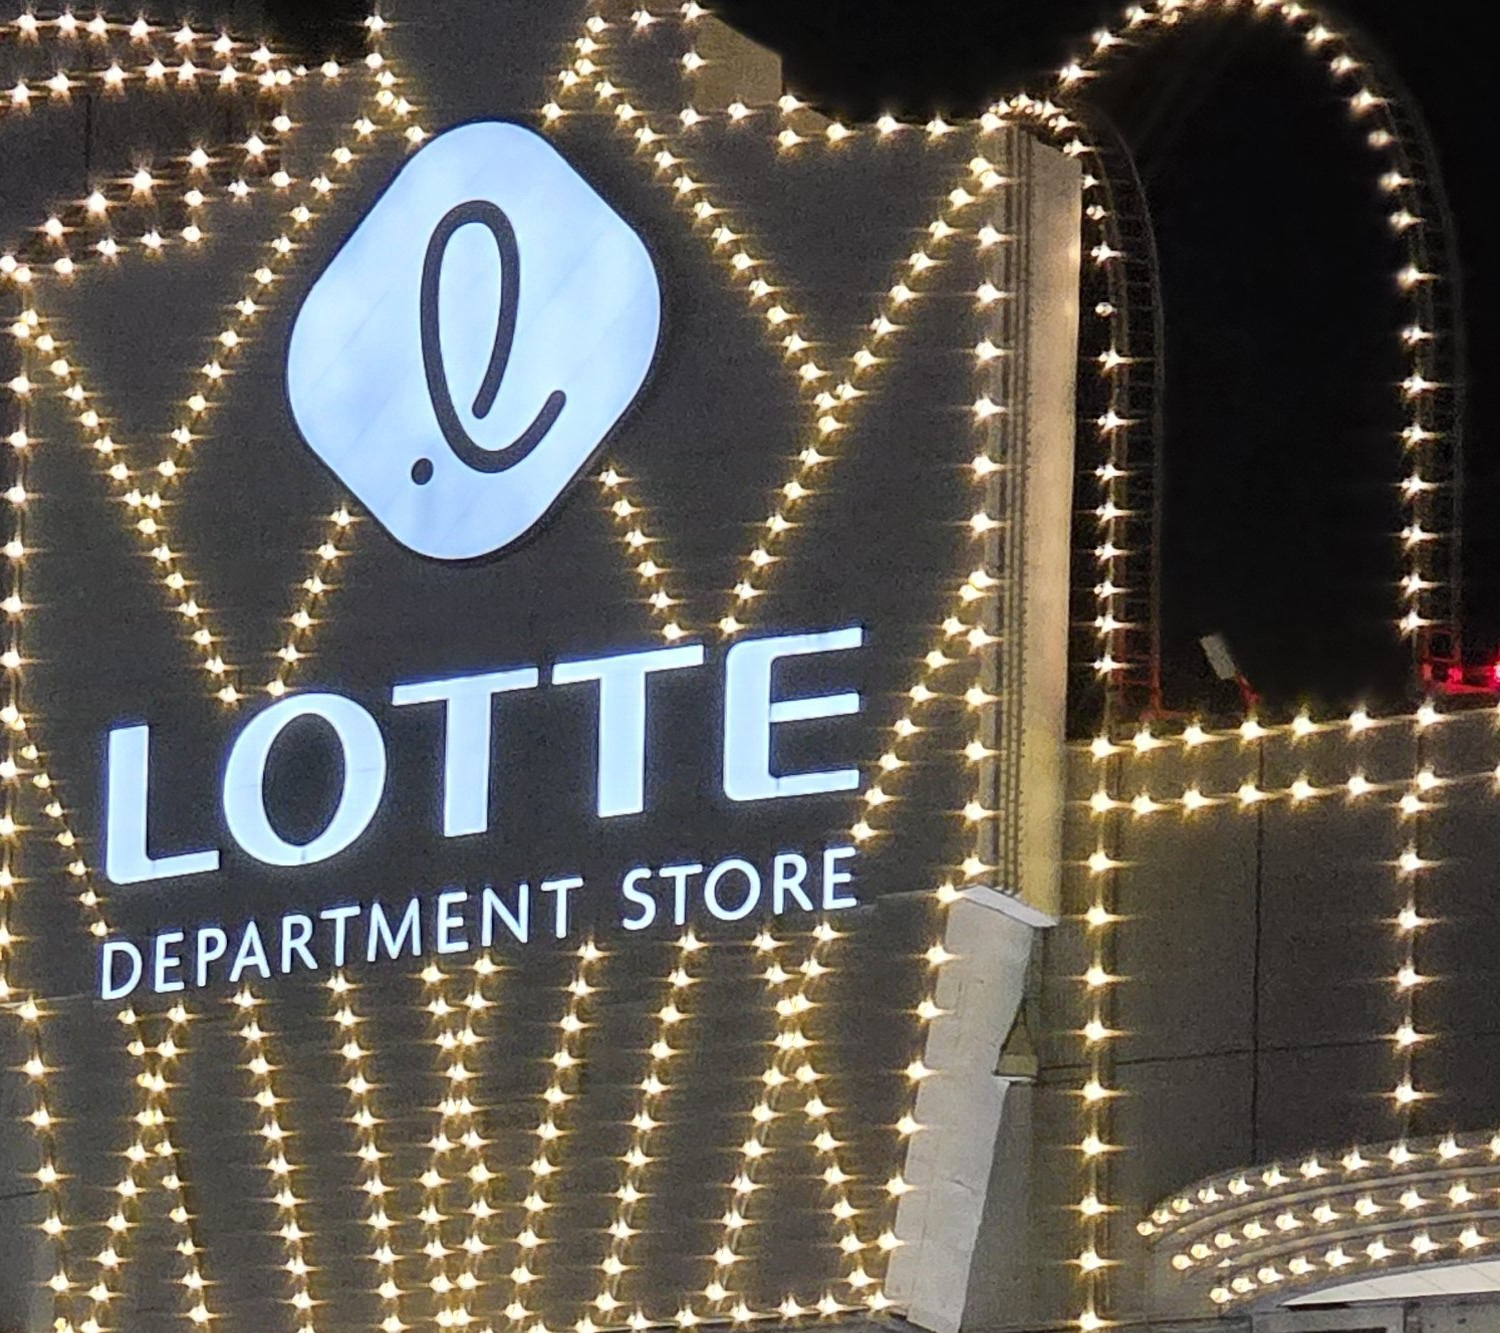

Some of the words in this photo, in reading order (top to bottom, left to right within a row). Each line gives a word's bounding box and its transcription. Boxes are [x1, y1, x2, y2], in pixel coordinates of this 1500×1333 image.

[106, 627, 864, 886] LOTTE
[101, 876, 585, 1000] DEPARTMENT
[621, 845, 859, 932] STORE
